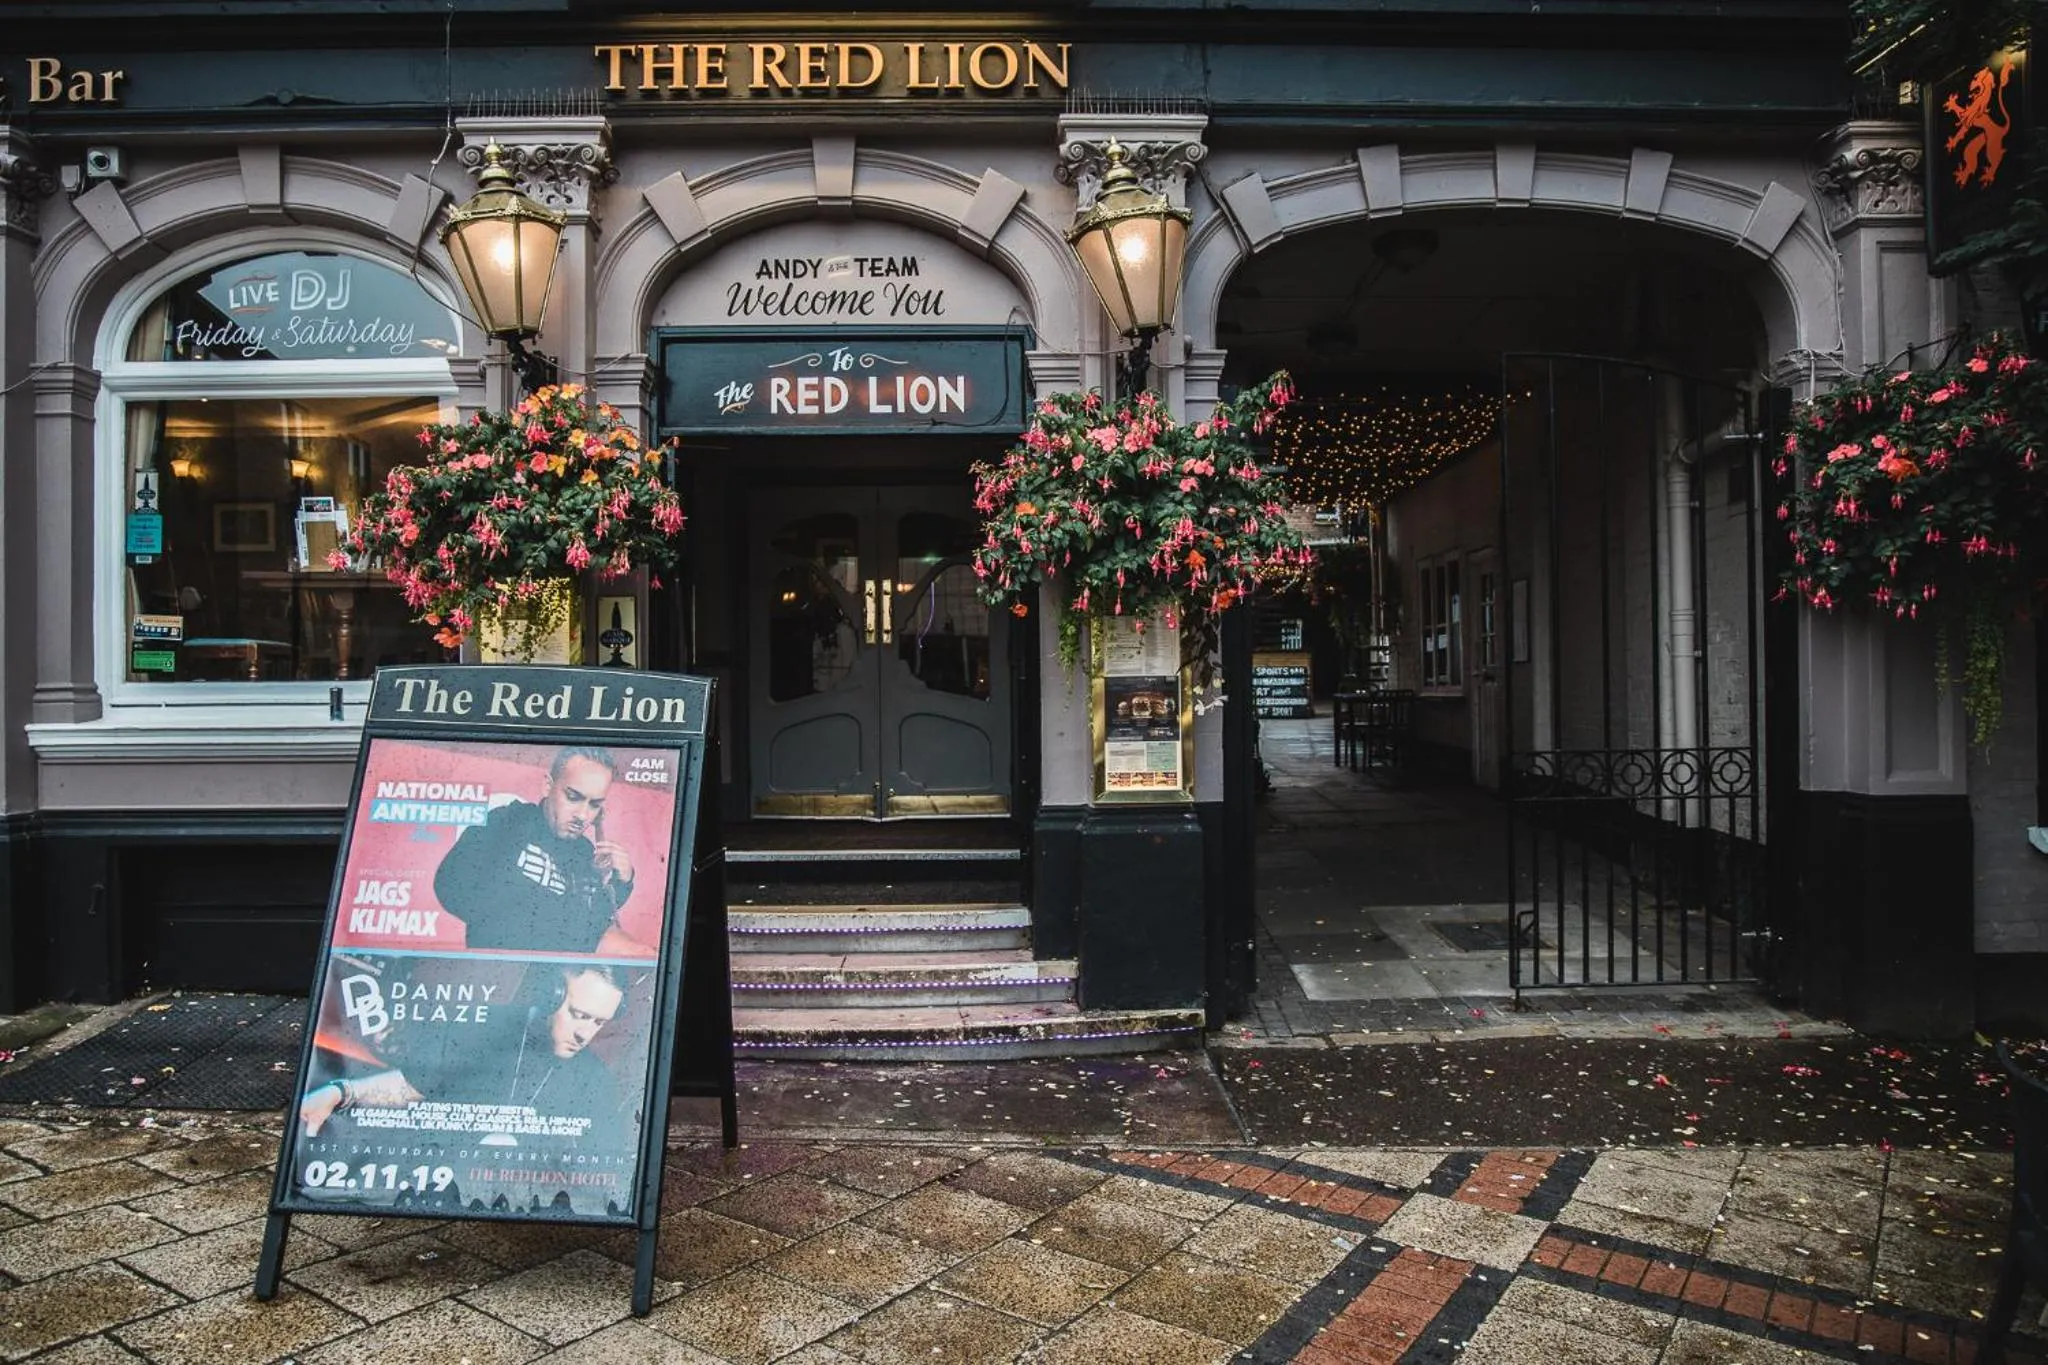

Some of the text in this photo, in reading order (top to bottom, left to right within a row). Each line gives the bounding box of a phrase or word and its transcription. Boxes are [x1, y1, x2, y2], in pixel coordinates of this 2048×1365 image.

[595, 42, 1072, 90] THE RED LION
[25, 57, 124, 102] Bar
[756, 258, 822, 279] ANDY
[854, 256, 920, 277] TEAM
[229, 269, 351, 310] LIVE DJ
[727, 282, 945, 316] Welcome You
[176, 315, 416, 357] Friday & Saturday
[828, 347, 855, 372] To
[713, 375, 965, 414] The RED LION
[1256, 667, 1289, 676] SPORTS
[395, 678, 686, 723] The Red Lion
[631, 758, 664, 769] 4AM
[625, 772, 668, 783] CLOSE
[377, 781, 488, 802] NATIONAL
[371, 802, 486, 825] ANTHEMS
[354, 880, 412, 907] JAGS
[349, 908, 439, 936] KLIMAX
[391, 982, 497, 1002] DANNY
[393, 1003, 489, 1023] BLAZE
[350, 1108, 365, 1117] UK
[408, 1102, 451, 1112] PLAYING
[310, 1143, 338, 1152] 1ST
[352, 1145, 445, 1157] SATURDAY
[494, 1151, 549, 1161] EVERY
[562, 1153, 624, 1164] MONTH
[304, 1160, 454, 1192] 02.11.19
